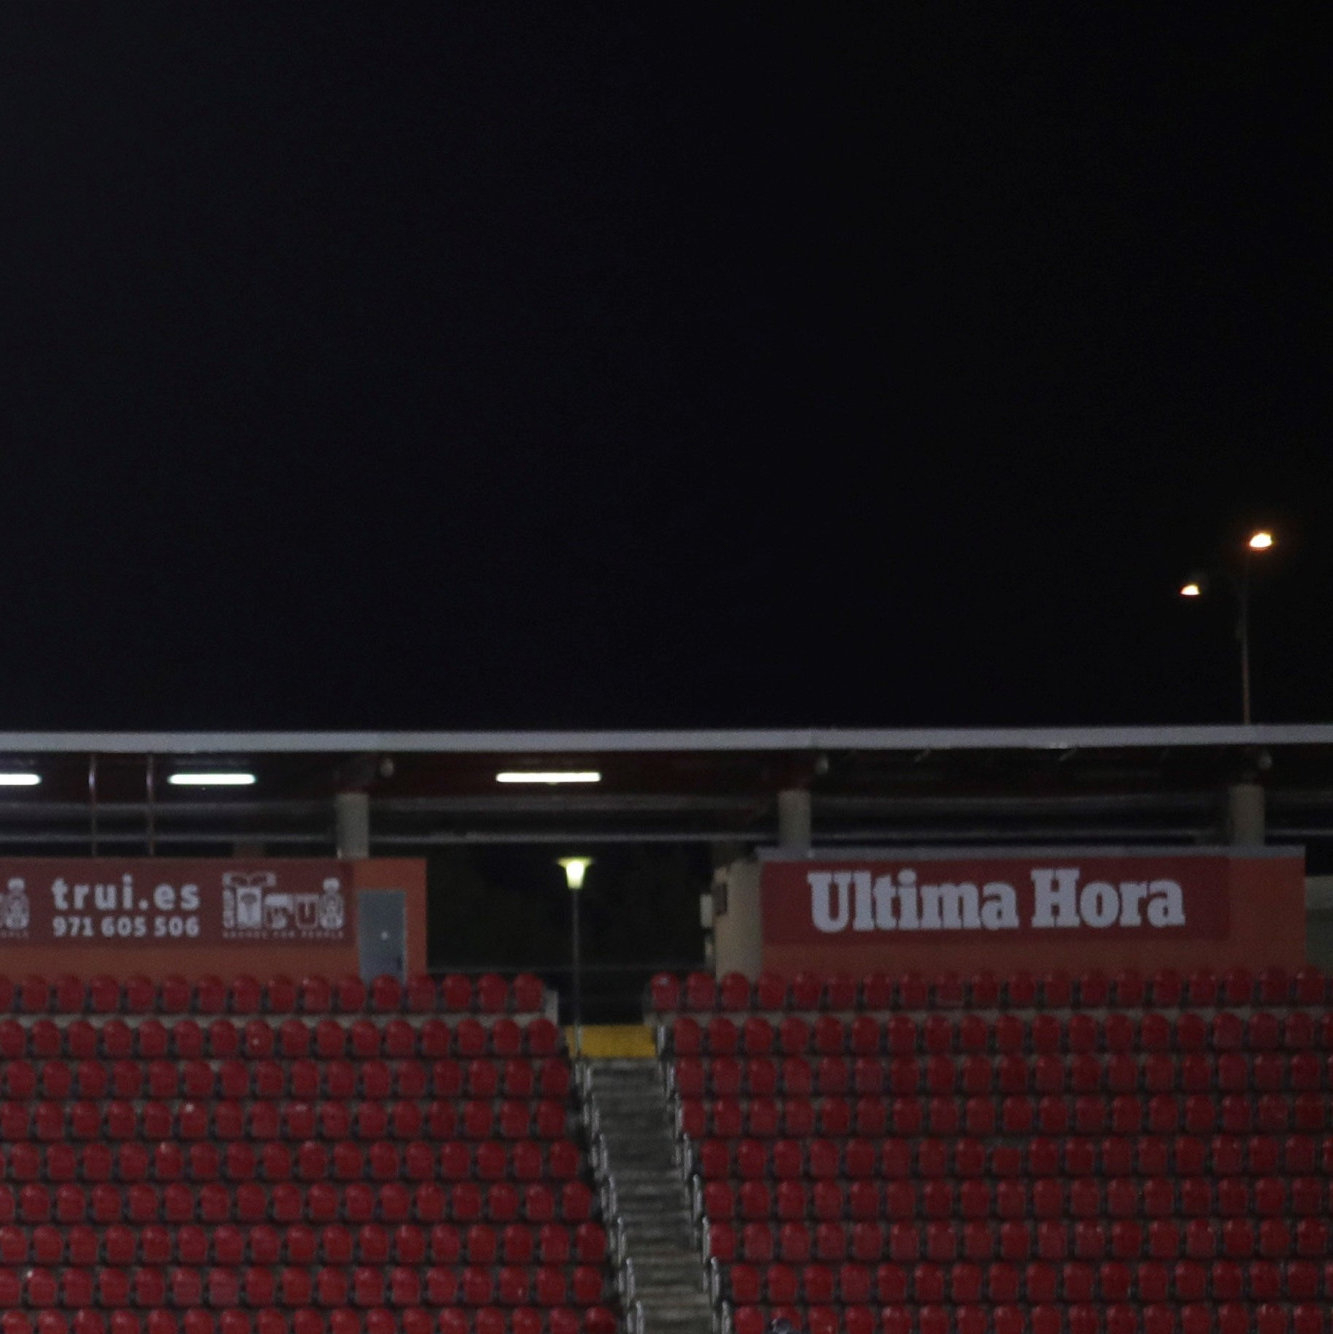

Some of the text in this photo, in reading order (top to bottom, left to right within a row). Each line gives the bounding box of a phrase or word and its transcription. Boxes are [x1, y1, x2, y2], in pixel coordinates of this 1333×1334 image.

[51, 874, 200, 911] trui.es
[807, 868, 1185, 933] Ultima Hora
[53, 916, 93, 937] 971
[100, 916, 146, 937] 605
[154, 916, 200, 937] 506
